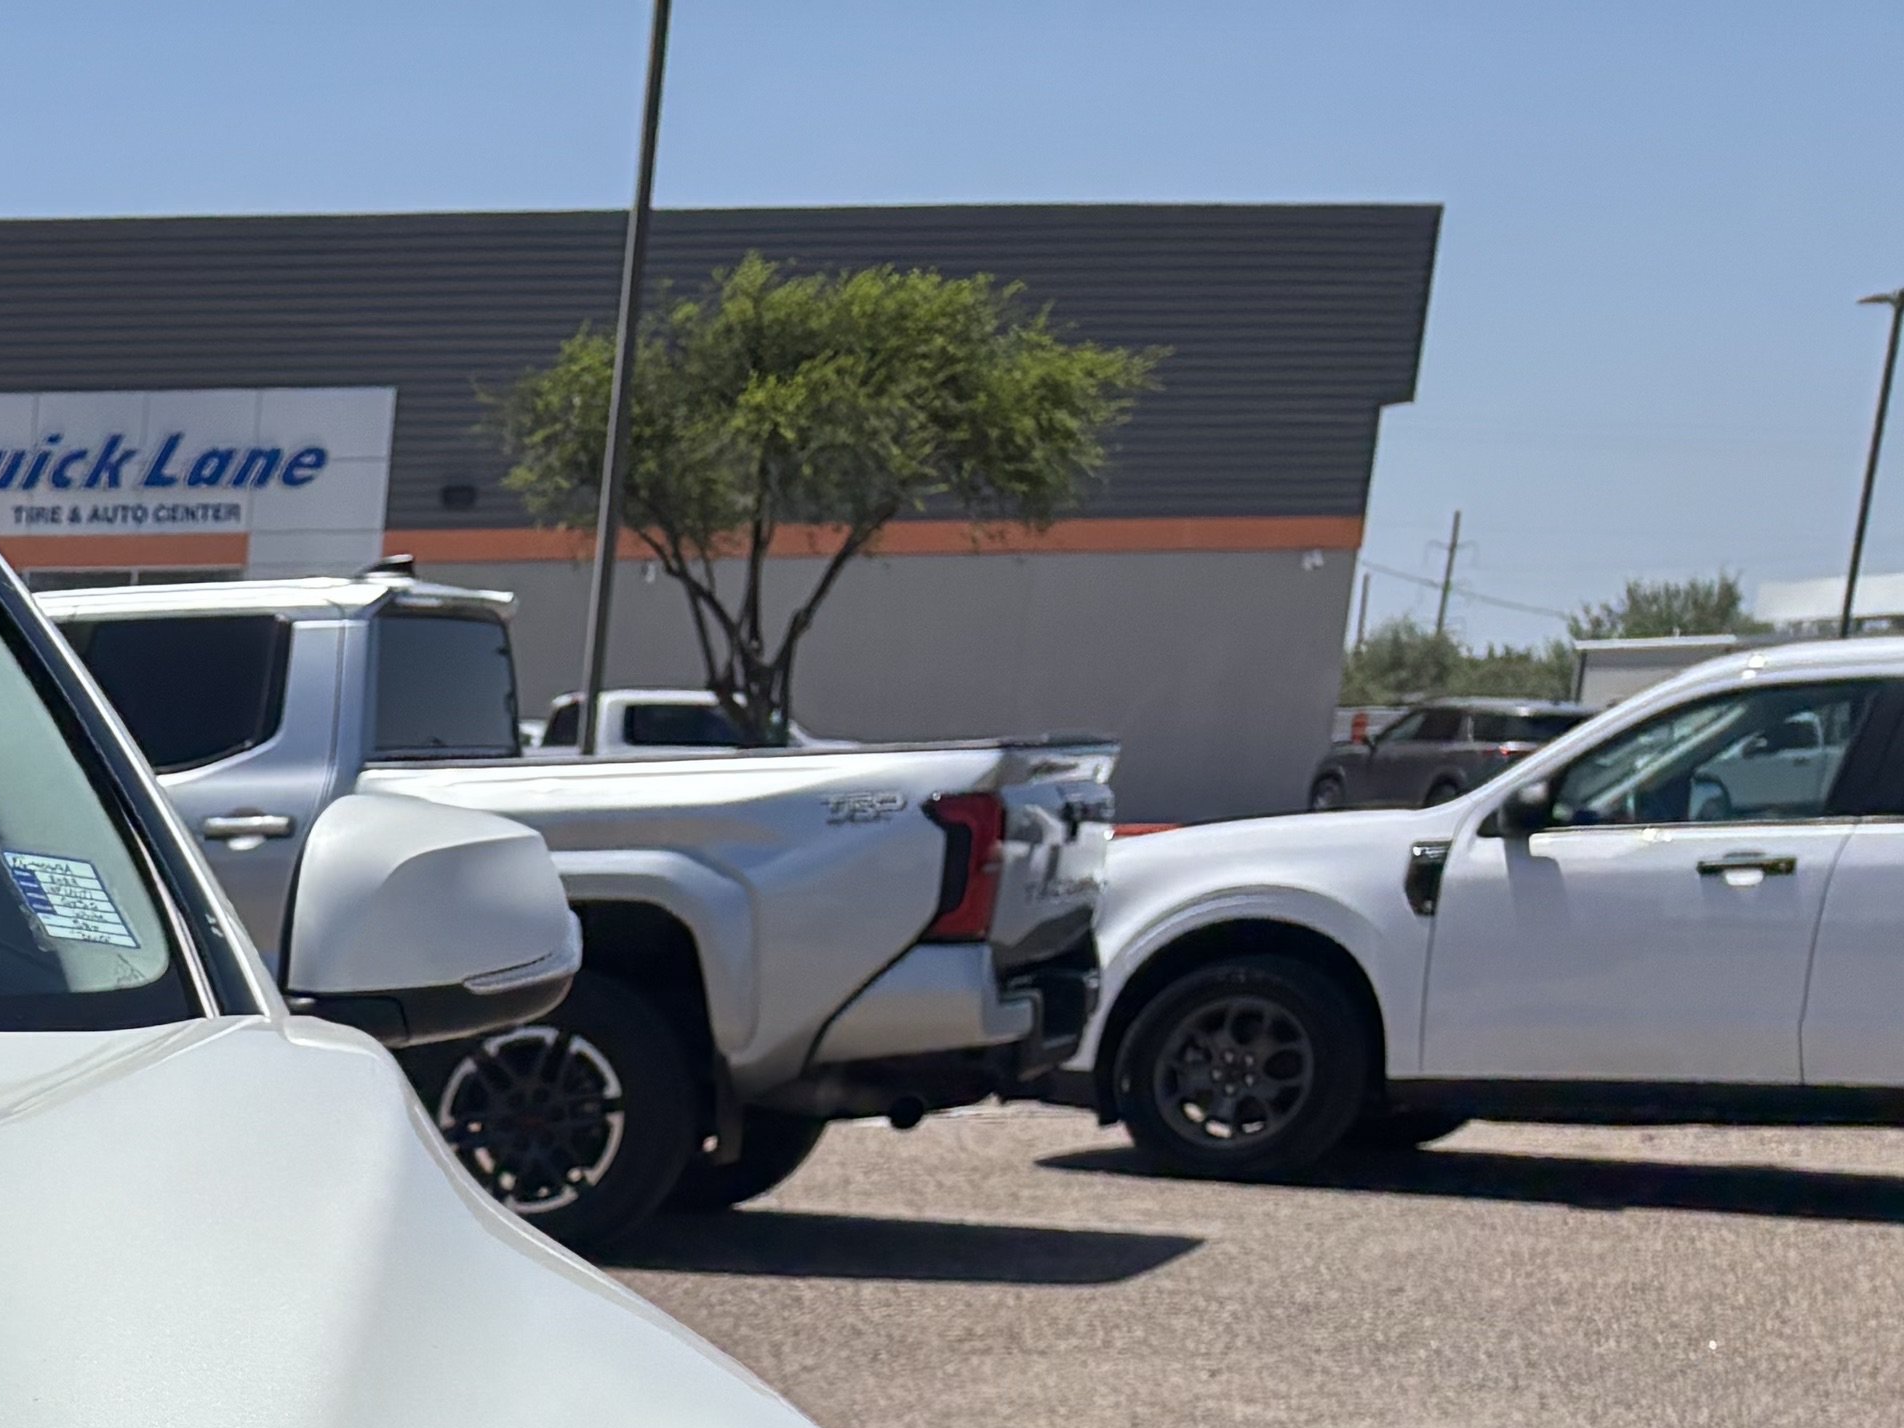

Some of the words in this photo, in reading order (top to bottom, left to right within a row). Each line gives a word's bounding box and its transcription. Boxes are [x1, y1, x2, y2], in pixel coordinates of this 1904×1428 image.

[143, 431, 330, 489] Lane
[11, 504, 63, 525] TIRE
[67, 504, 80, 523] &
[87, 503, 144, 523] AUTO
[152, 503, 241, 523] CENTER
